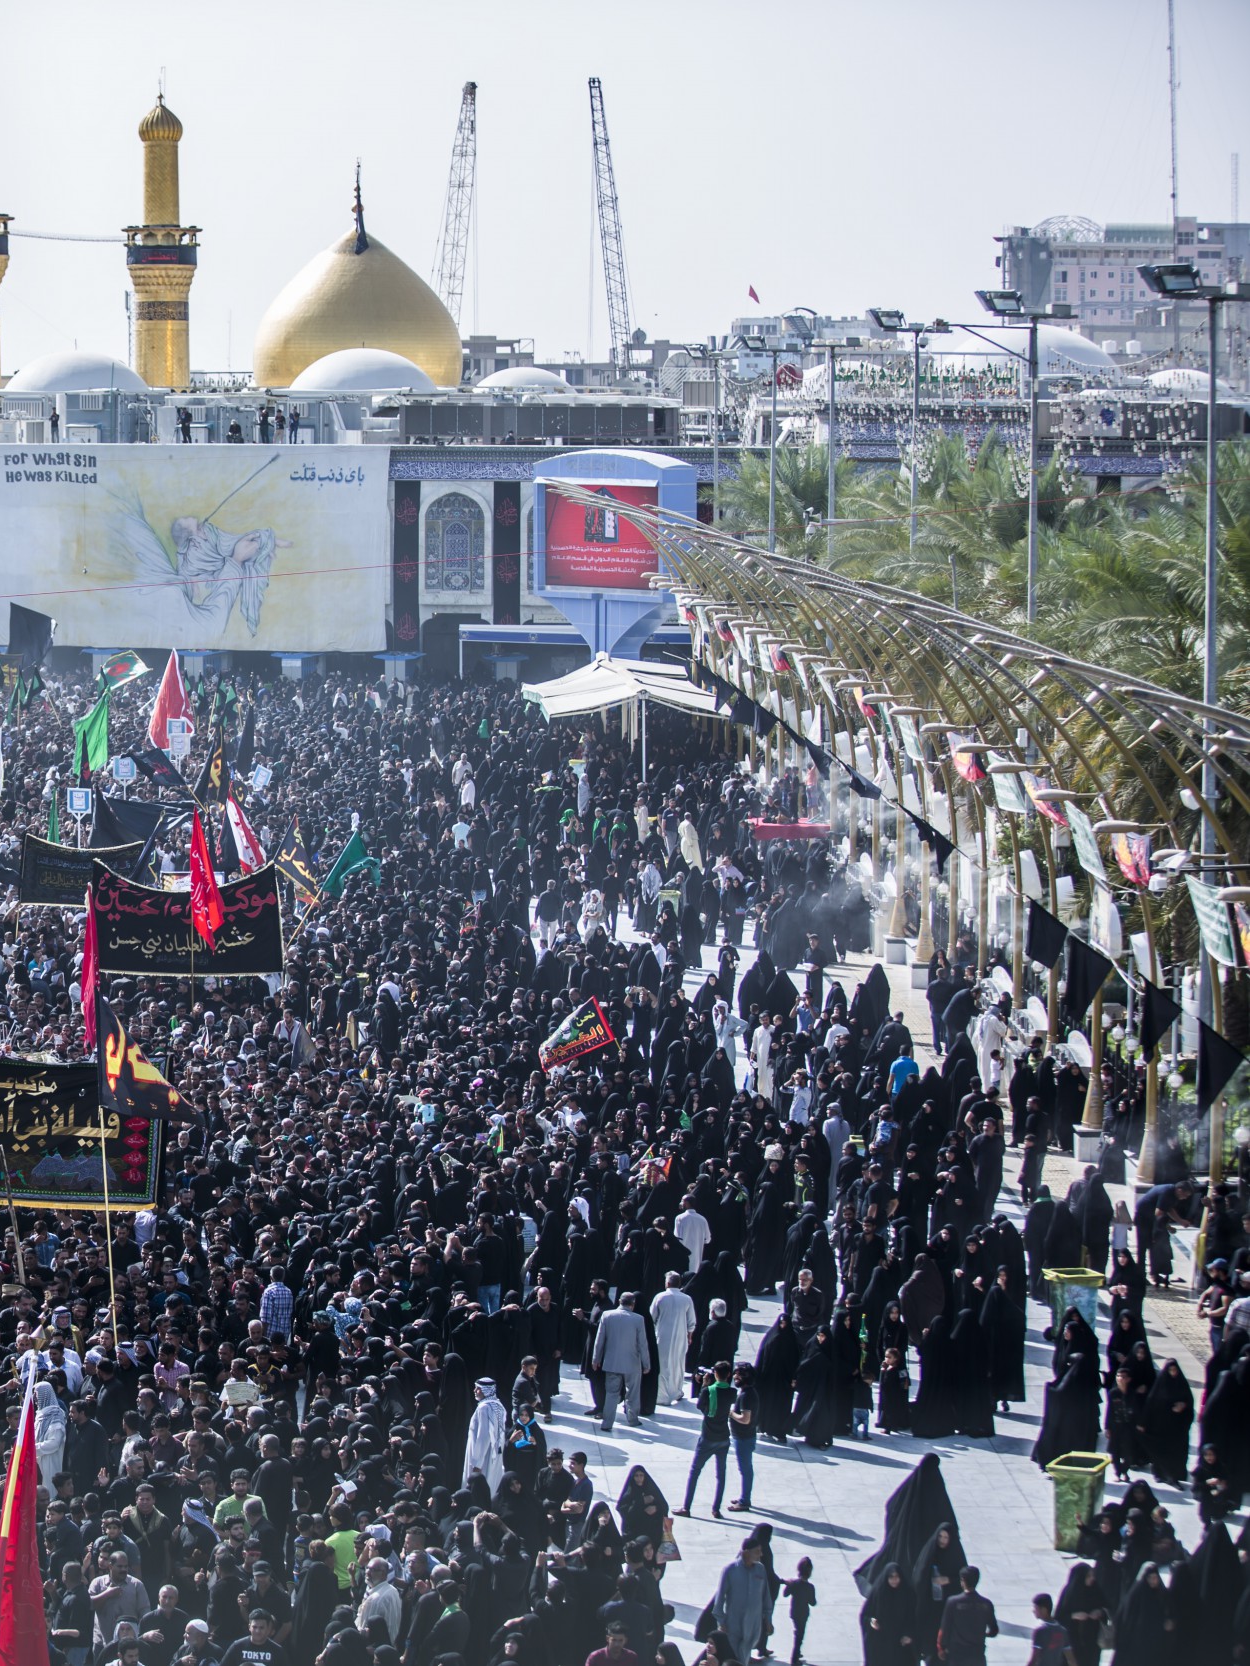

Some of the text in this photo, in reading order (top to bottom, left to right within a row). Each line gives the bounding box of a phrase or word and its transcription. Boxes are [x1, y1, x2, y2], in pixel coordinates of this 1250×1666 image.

[4, 452, 97, 468] For What Sin
[5, 470, 22, 483] He
[222, 883, 277, 922] موكب
[140, 928, 163, 959] بني
[14, 1070, 59, 1097] موكب
[11, 1105, 50, 1153] بني
[50, 1103, 121, 1149] قبيلة
[241, 1650, 272, 1661] TOKYO
